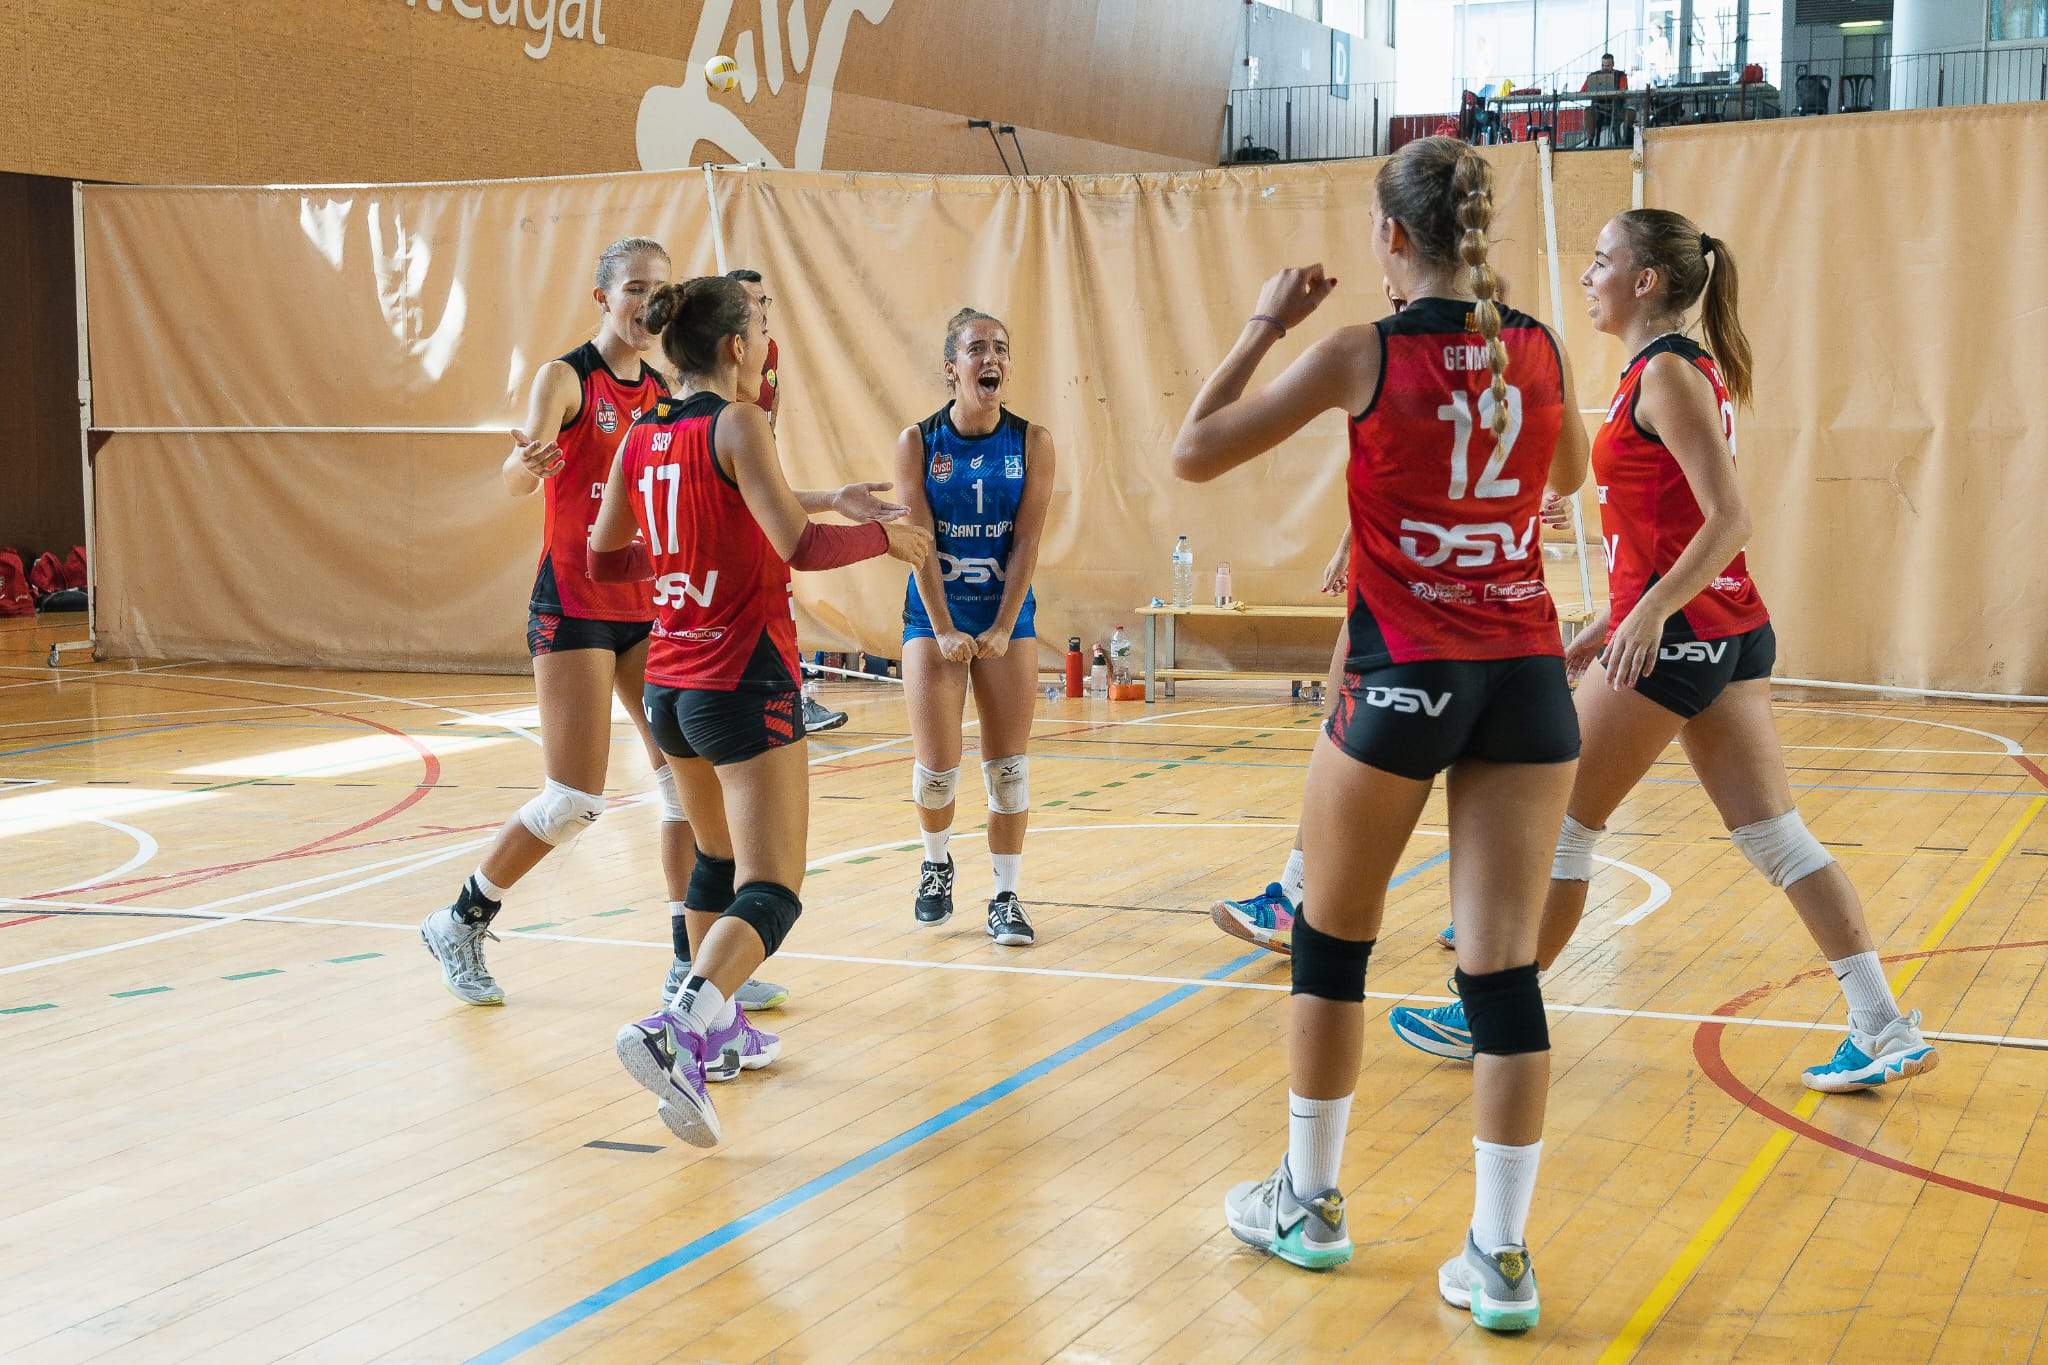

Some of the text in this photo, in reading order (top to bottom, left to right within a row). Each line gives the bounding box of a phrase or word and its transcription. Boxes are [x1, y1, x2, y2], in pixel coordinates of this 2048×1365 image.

[1335, 41, 1347, 85] D
[1437, 384, 1523, 499] 12
[932, 461, 951, 474] CVSC
[638, 463, 681, 556] 17
[971, 478, 984, 514] 1
[950, 524, 982, 538] SANT
[1400, 516, 1537, 568] DSV
[950, 594, 981, 602] Transport
[1659, 641, 1728, 664] DSV
[1366, 686, 1453, 717] DSV
